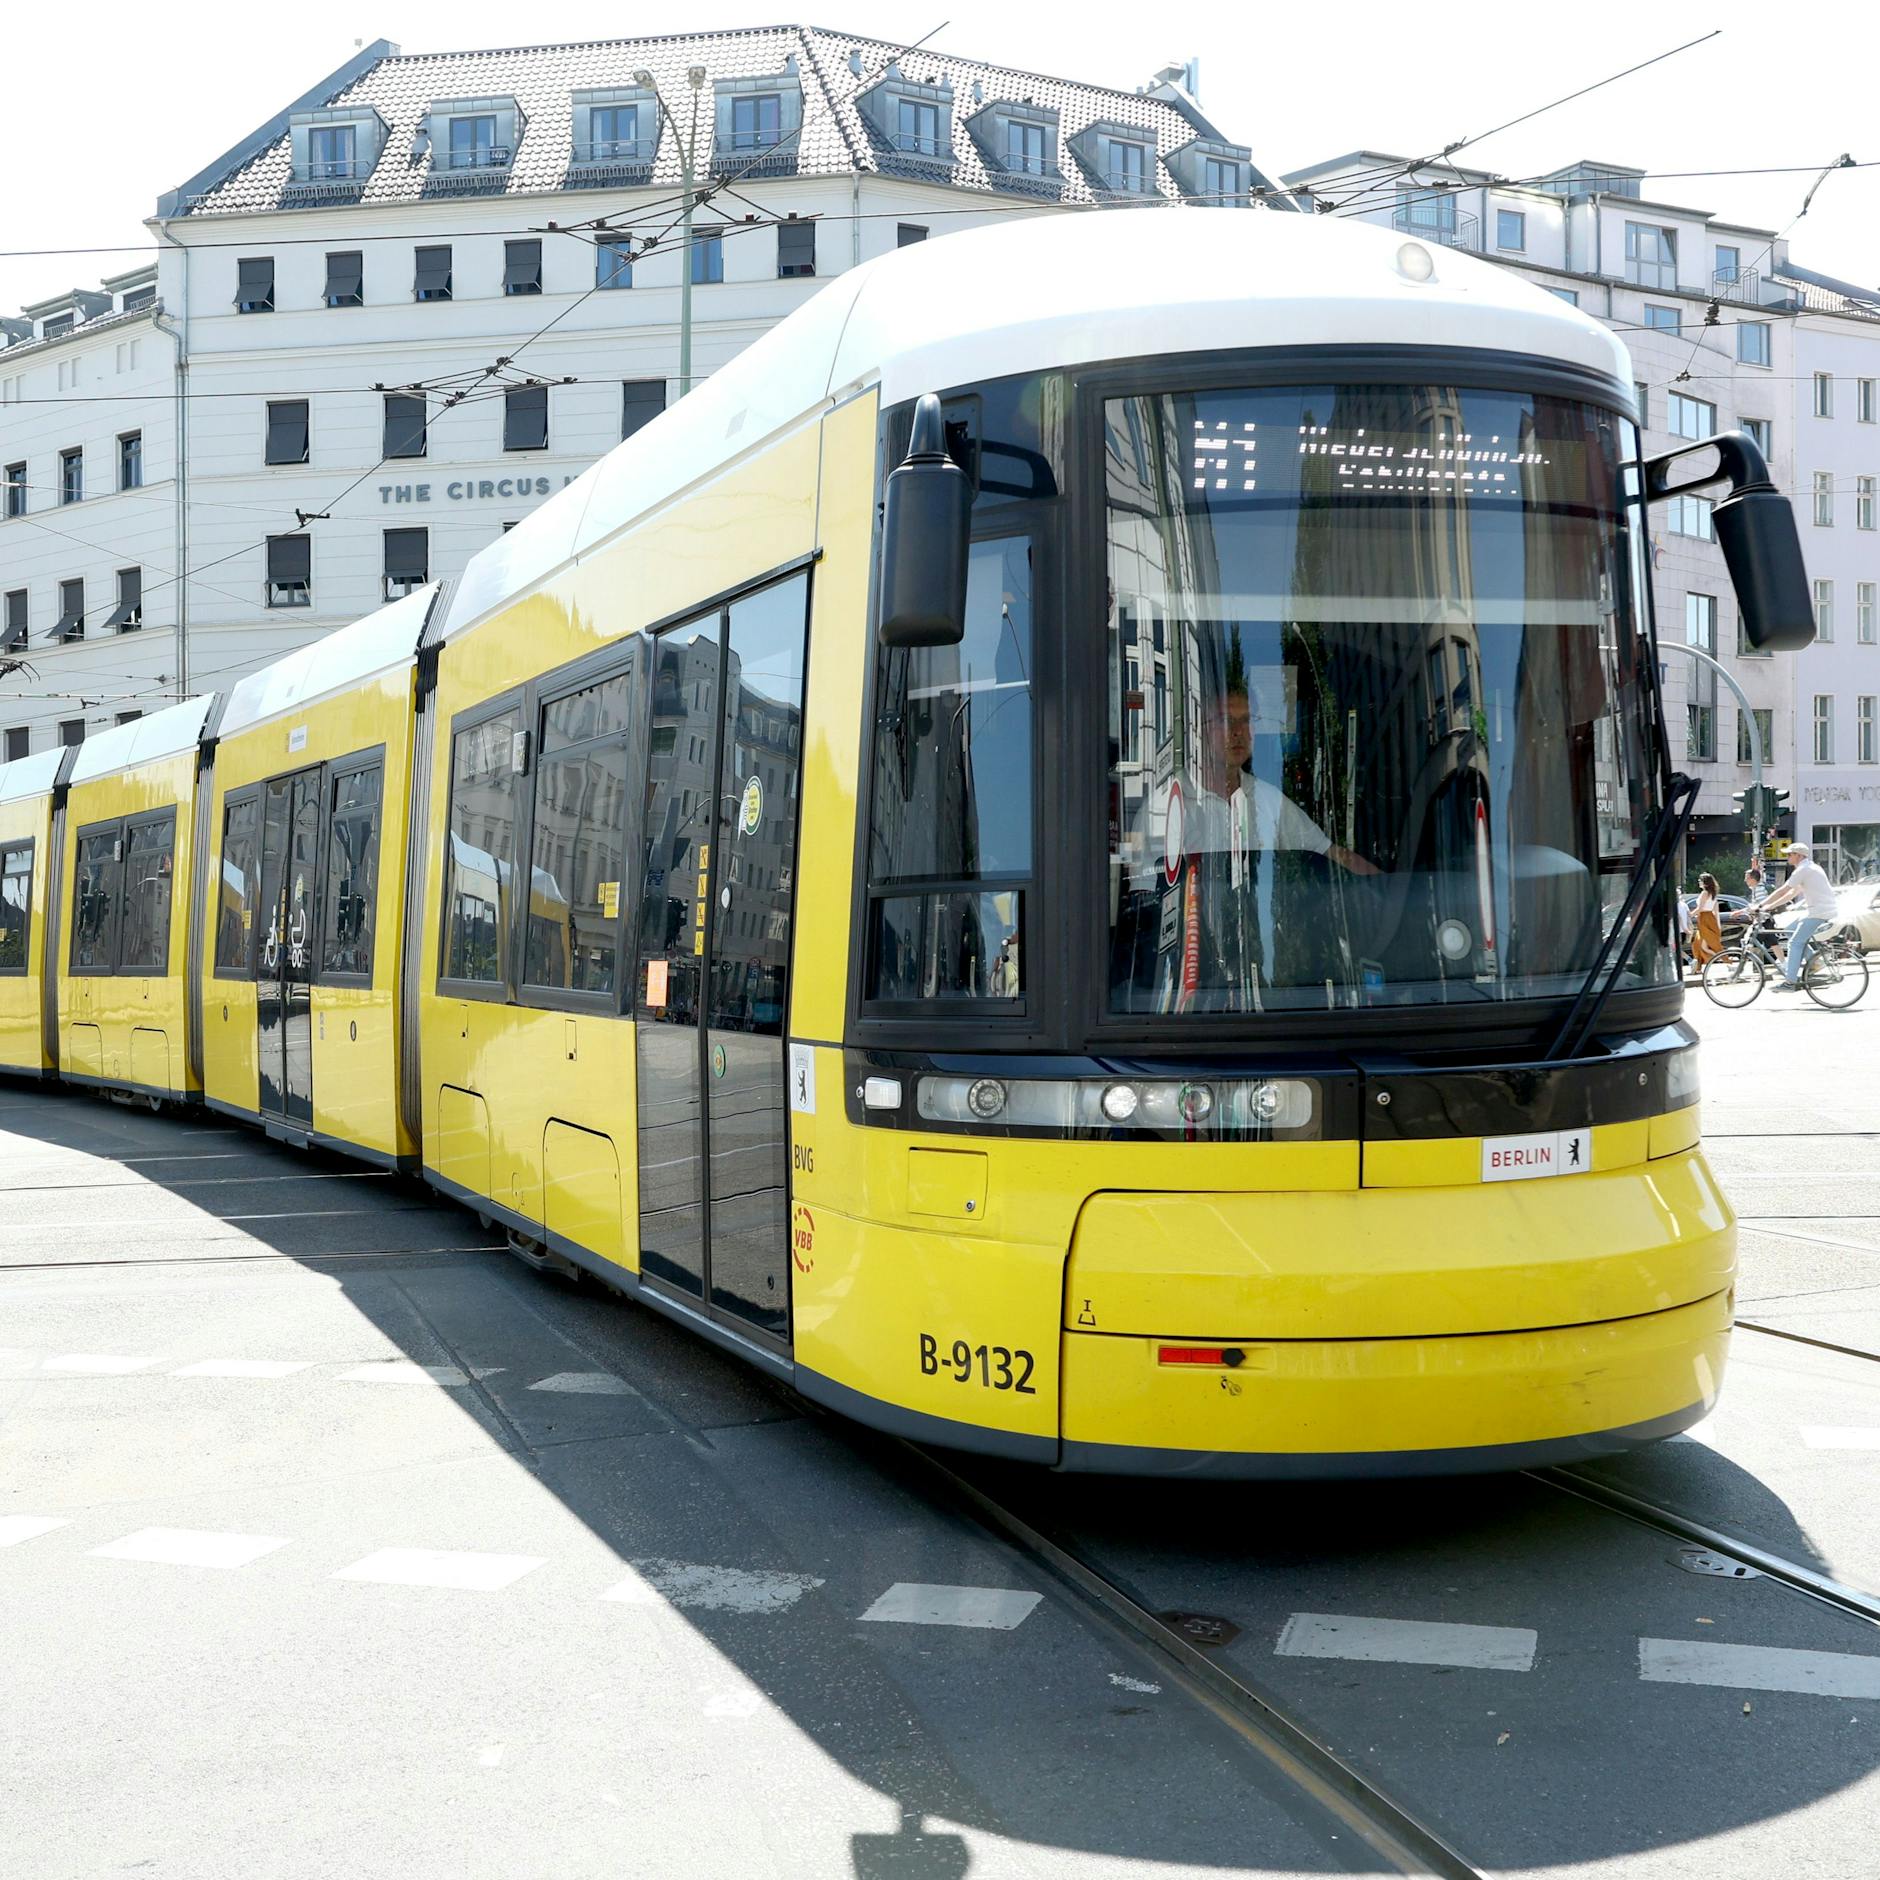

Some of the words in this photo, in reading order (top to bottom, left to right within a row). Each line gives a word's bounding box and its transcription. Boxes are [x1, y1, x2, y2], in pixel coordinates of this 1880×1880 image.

[379, 484, 431, 504] THE
[447, 476, 550, 501] CIRCUS
[794, 1144, 814, 1173] BVG
[1491, 1147, 1551, 1168] BERLIN
[794, 1228, 813, 1252] VBB
[920, 1333, 1036, 1394] B-9132
